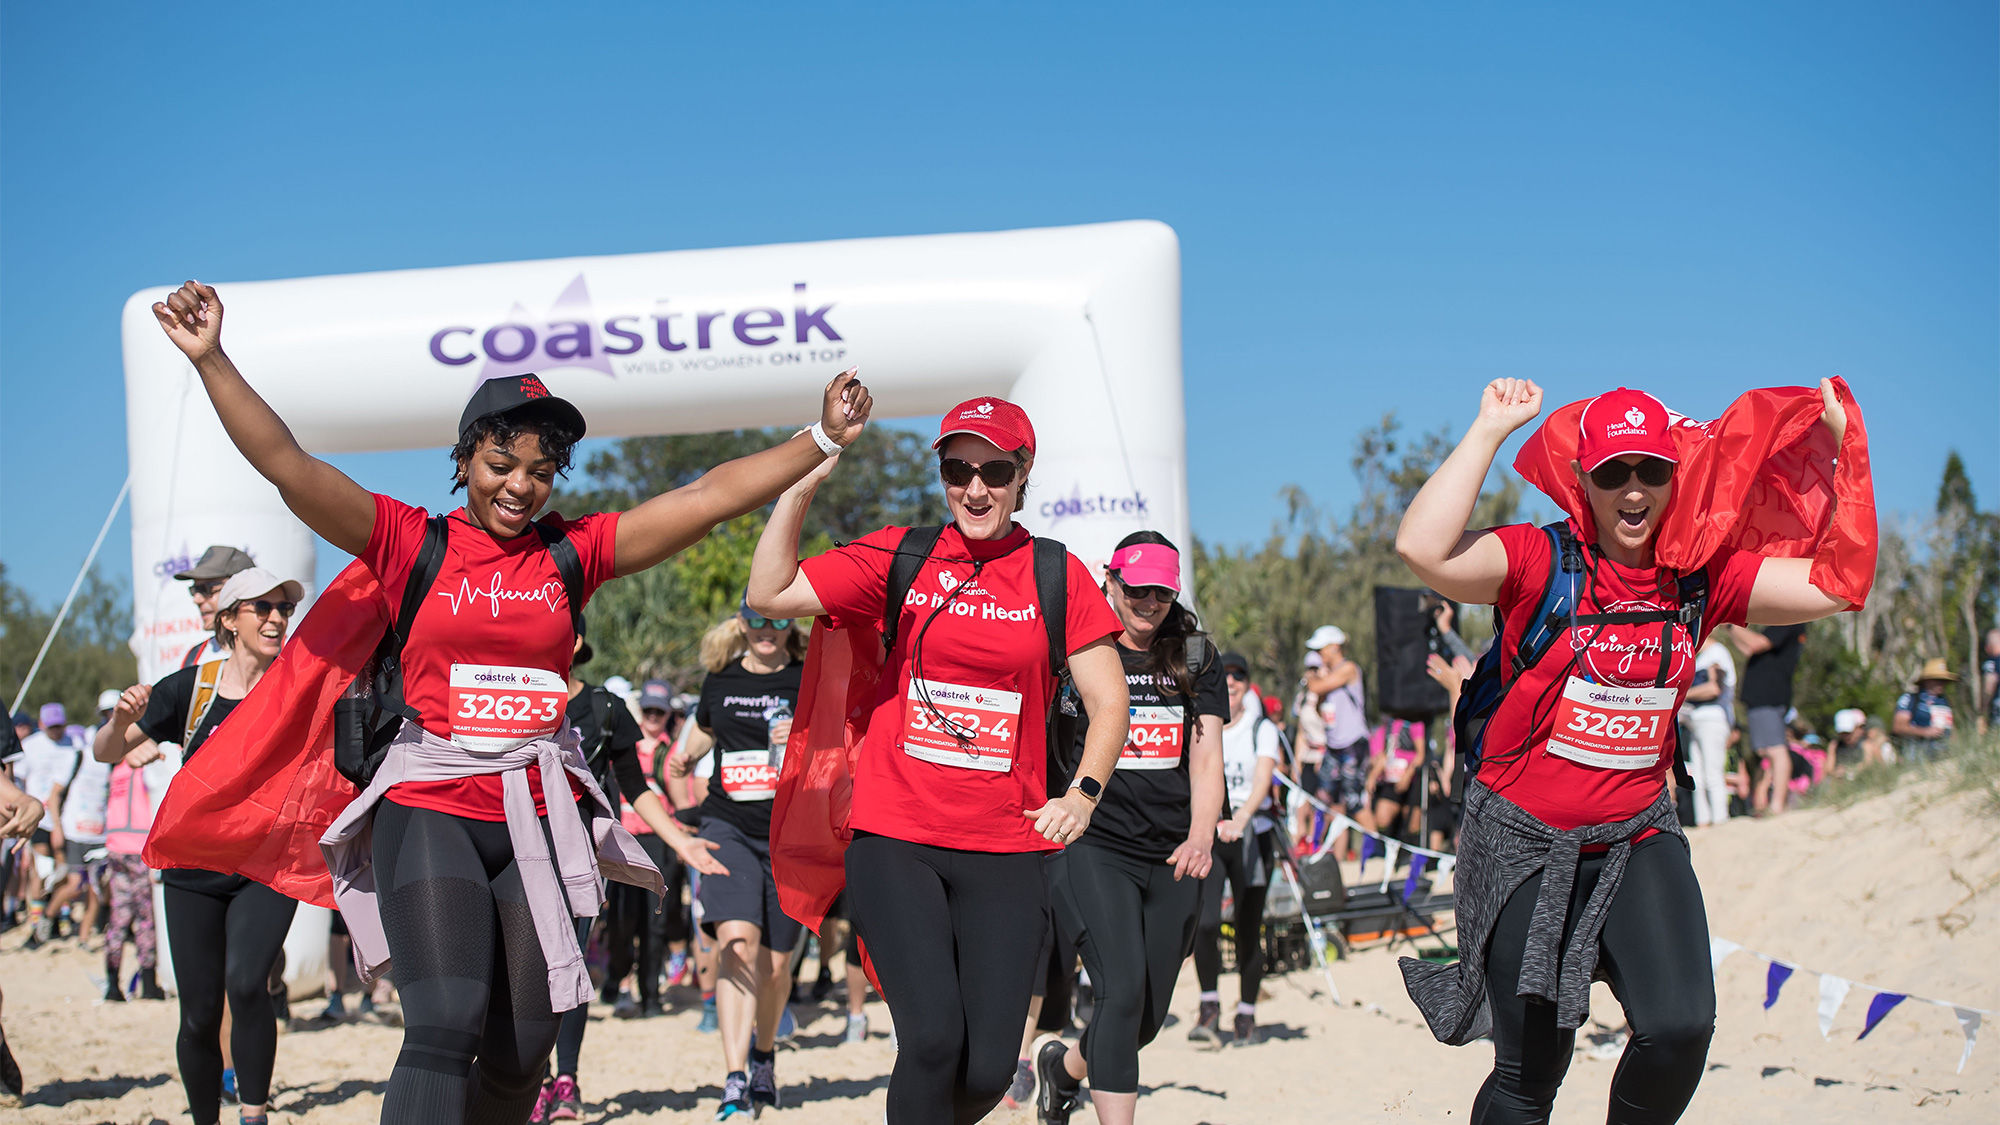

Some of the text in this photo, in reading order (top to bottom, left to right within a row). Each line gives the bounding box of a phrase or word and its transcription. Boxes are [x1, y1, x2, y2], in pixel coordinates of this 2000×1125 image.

[430, 283, 844, 366] coastrek
[624, 347, 846, 374] WILD WOMEN ON TOP
[1607, 421, 1626, 431] Heart
[1608, 427, 1647, 438] Foundation
[1040, 491, 1149, 518] coastrek
[488, 571, 545, 618] fierce
[906, 588, 928, 606] Do
[948, 598, 978, 617] for
[982, 602, 1036, 621] Heart
[474, 672, 516, 682] coastrek
[1624, 679, 1656, 687] Foundat
[723, 695, 780, 707] powerful
[930, 689, 970, 700] coastrek
[1144, 693, 1160, 703] days
[1588, 692, 1630, 703] coastrek
[457, 694, 558, 722] 3262-3
[910, 706, 1010, 742] 3262-4
[1566, 707, 1660, 739] 3262-1
[908, 734, 924, 742] HEART
[924, 738, 957, 748] FOUNDATION
[1125, 727, 1178, 746] 04-1
[1556, 732, 1574, 742] HEART
[1574, 739, 1610, 750] FOUNDATION
[723, 766, 778, 784] 3004-
